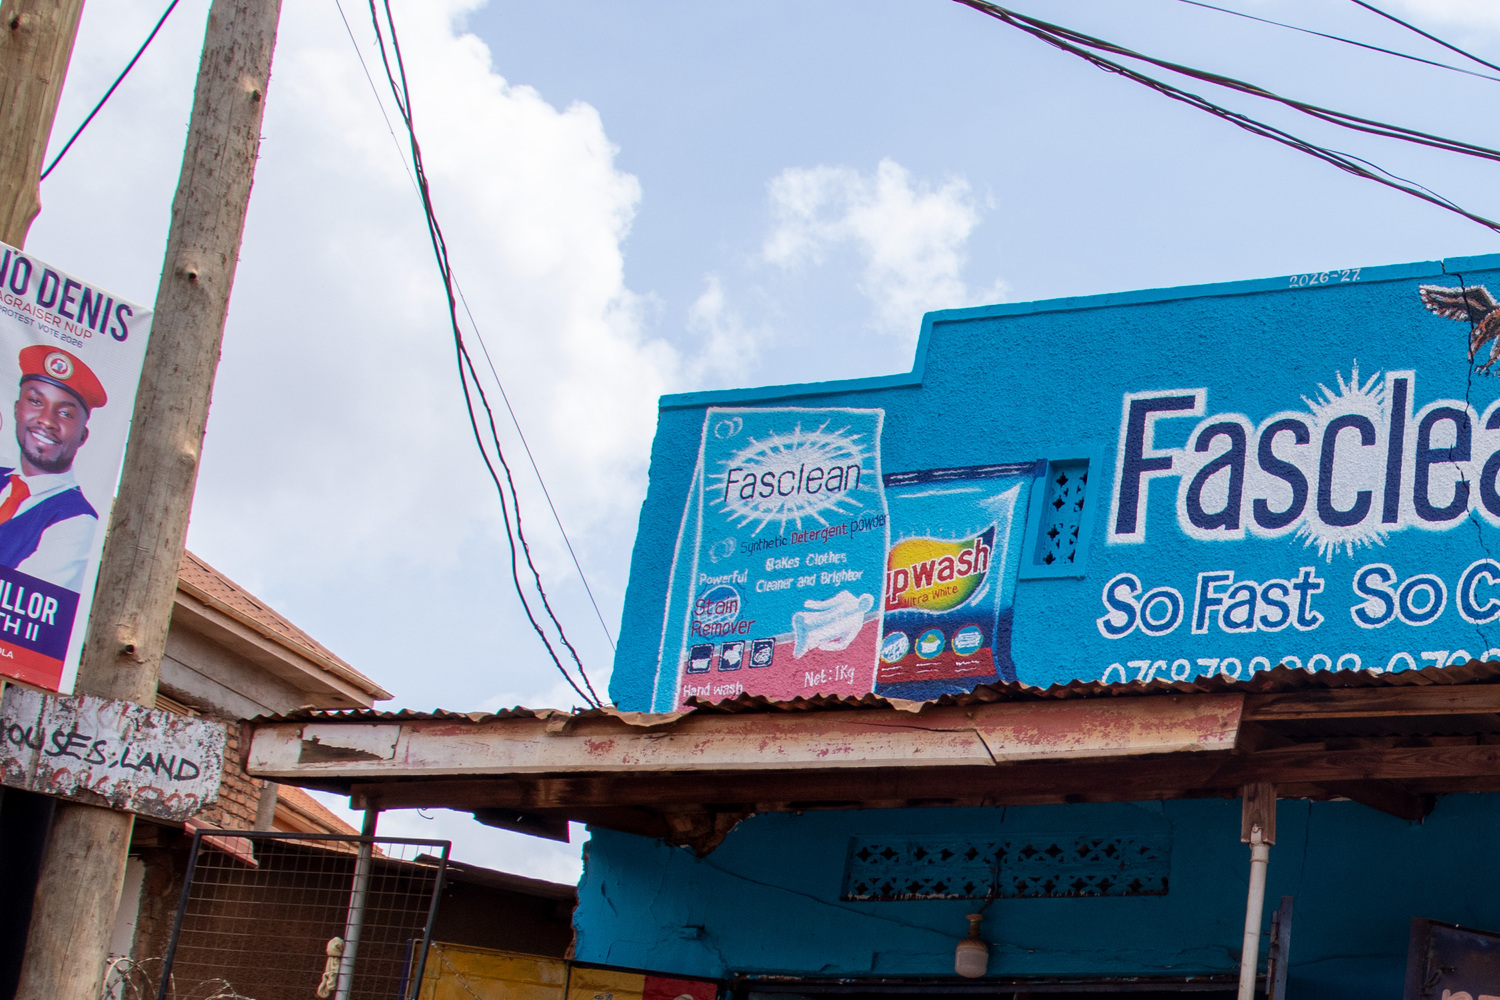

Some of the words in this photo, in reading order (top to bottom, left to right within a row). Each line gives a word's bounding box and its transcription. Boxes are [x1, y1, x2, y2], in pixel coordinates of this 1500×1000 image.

[36, 267, 133, 342] DENIS
[38, 321, 59, 339] VOTE
[60, 333, 83, 348] 2026
[64, 321, 93, 339] NUP
[724, 463, 861, 503] Fasclean
[740, 535, 788, 556] Synthetic
[790, 522, 849, 546] Detergent
[850, 513, 889, 540] powder
[806, 551, 847, 568] Clothes
[699, 570, 748, 587] Powerful
[755, 575, 794, 593] Cleaner
[797, 573, 816, 588] and
[930, 585, 960, 601] White
[1097, 573, 1184, 639] So
[1191, 567, 1324, 635] Fast
[1351, 562, 1448, 629] So
[693, 597, 739, 618] Stain
[690, 619, 756, 639] Remover
[683, 683, 710, 698] Hand
[712, 681, 743, 696] wash
[121, 746, 200, 782] LAND
